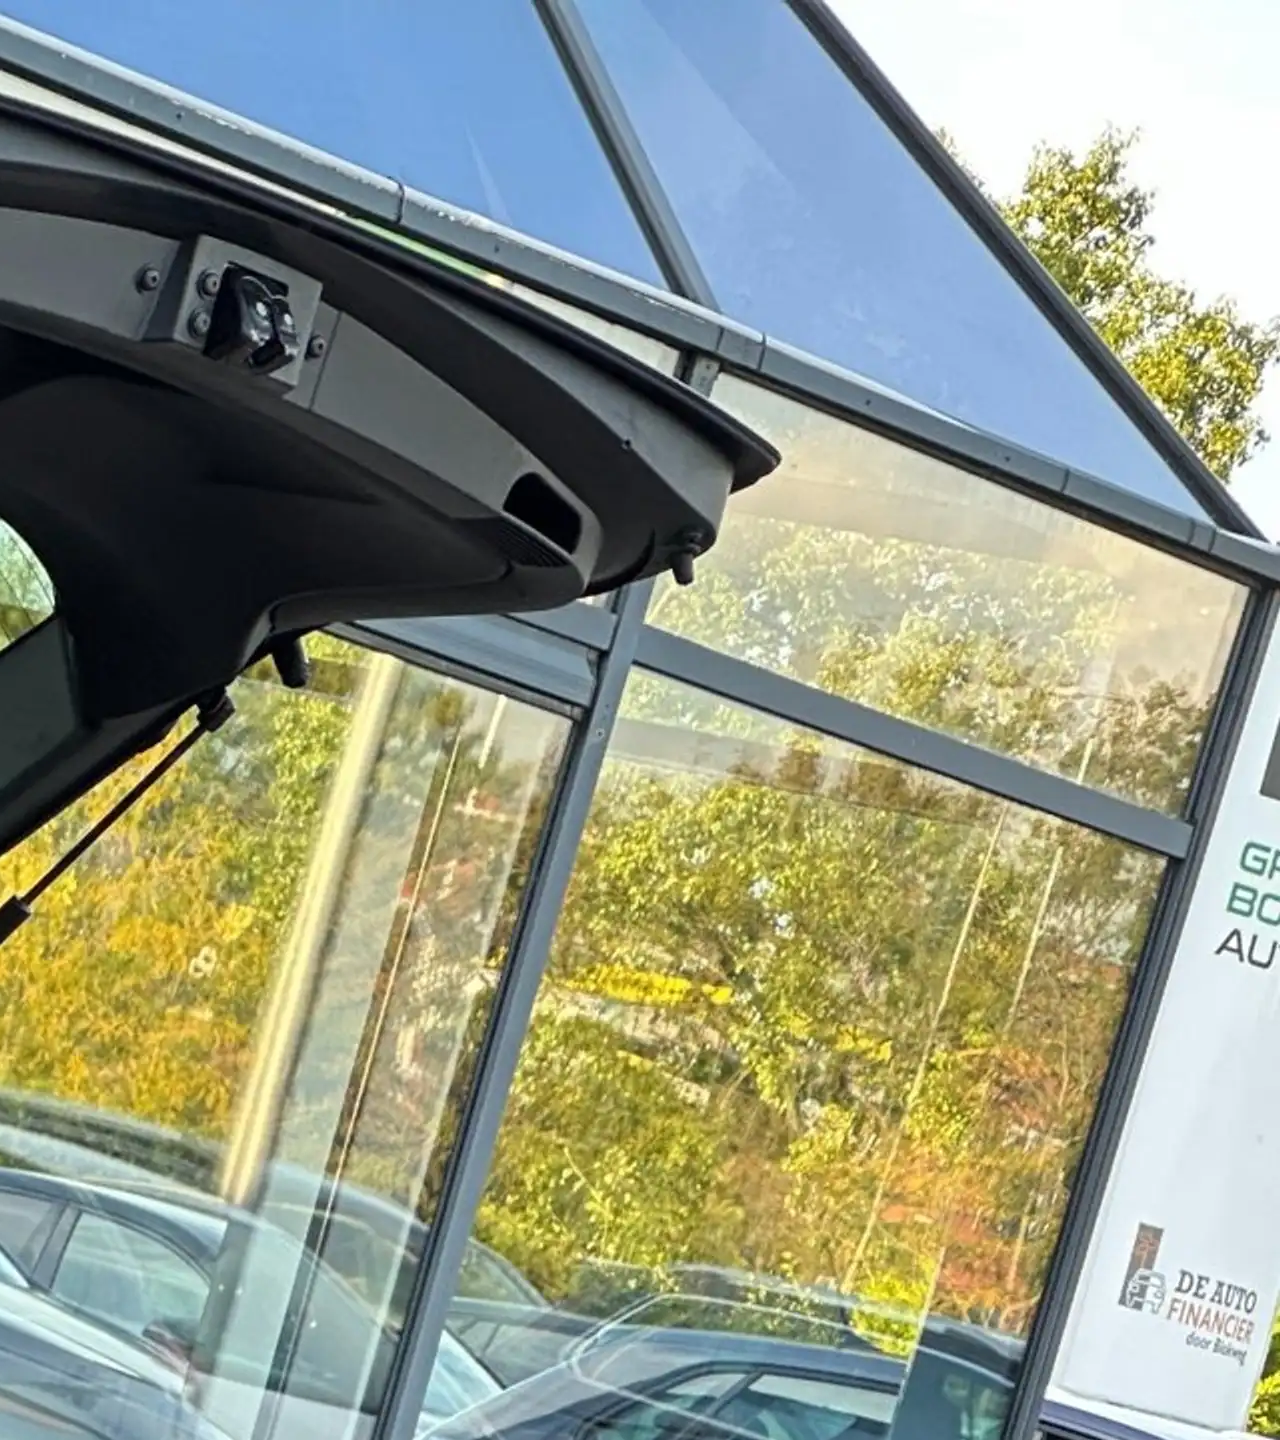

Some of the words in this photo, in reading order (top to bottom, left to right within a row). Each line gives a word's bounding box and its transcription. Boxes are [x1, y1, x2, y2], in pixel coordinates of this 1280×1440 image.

[1214, 927, 1280, 970] AU
[1175, 1269, 1209, 1299] DE
[1211, 1281, 1257, 1313] AUTO
[1167, 1298, 1255, 1343] FINANCIER
